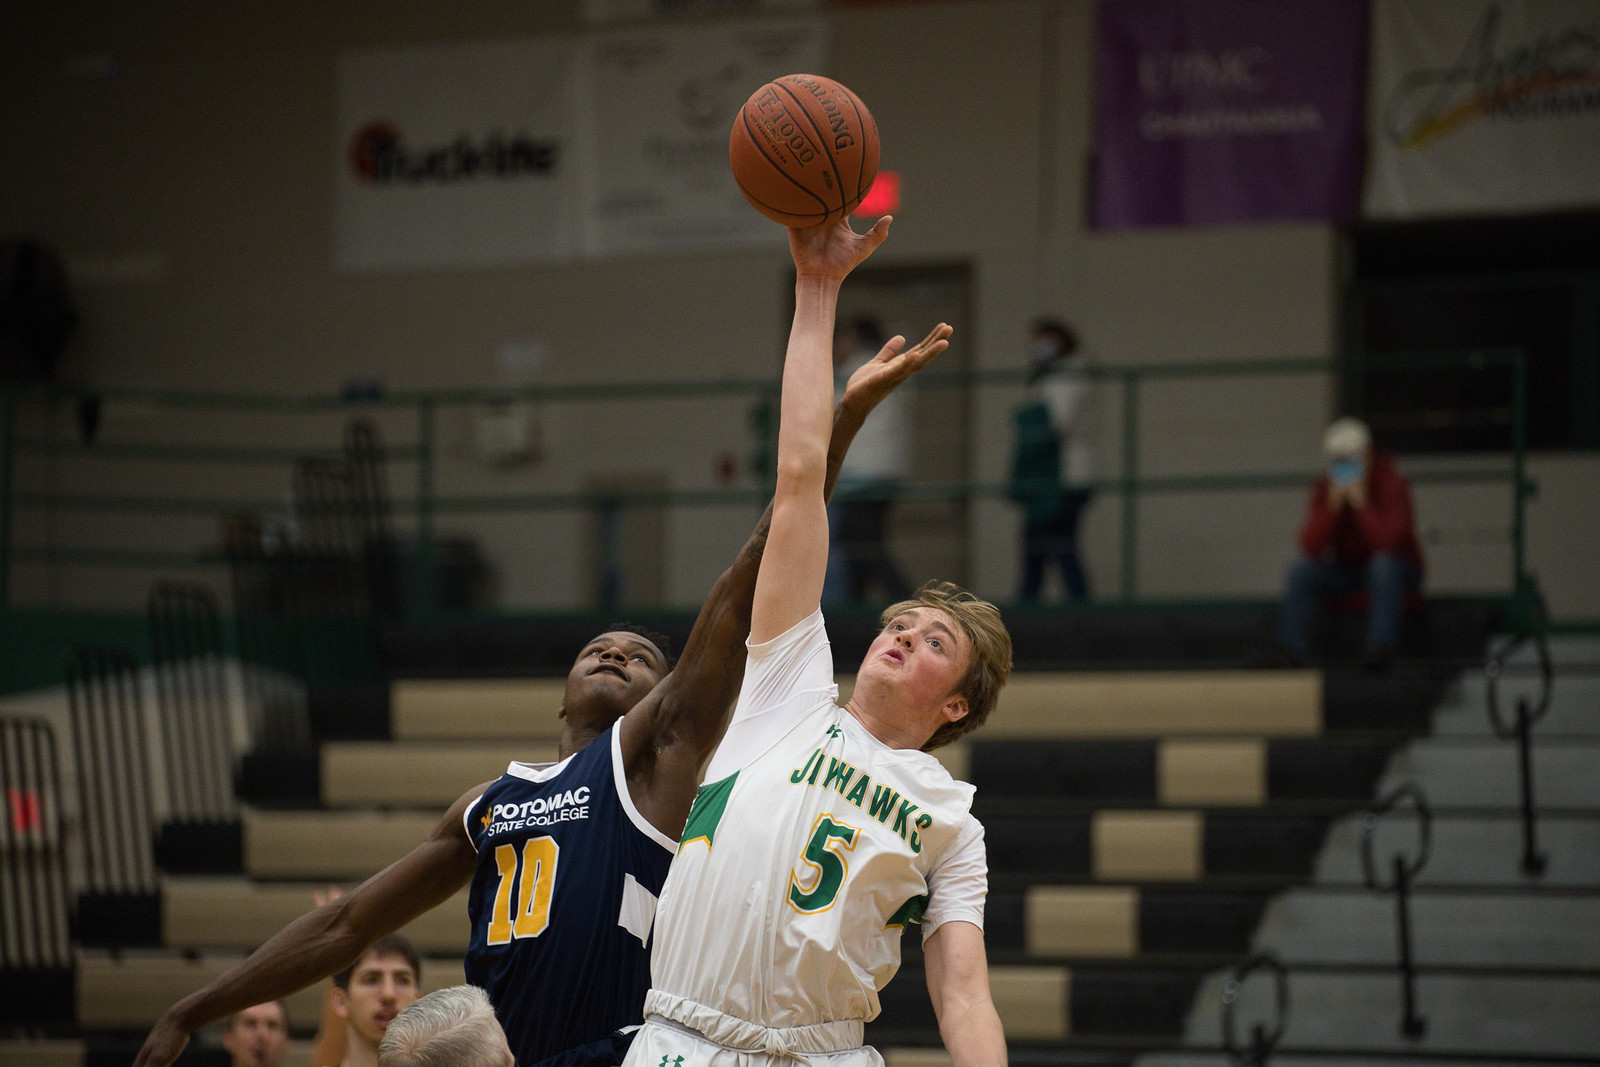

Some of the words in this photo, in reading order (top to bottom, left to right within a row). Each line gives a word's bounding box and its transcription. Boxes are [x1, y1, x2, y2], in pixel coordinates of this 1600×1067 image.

[758, 89, 815, 163] TF-1000
[786, 75, 854, 150] SPALDING
[488, 819, 524, 837] STATE
[526, 806, 589, 827] COLLEGE
[492, 786, 591, 822] POTOMAC
[487, 835, 560, 946] 10
[786, 812, 863, 916] 5
